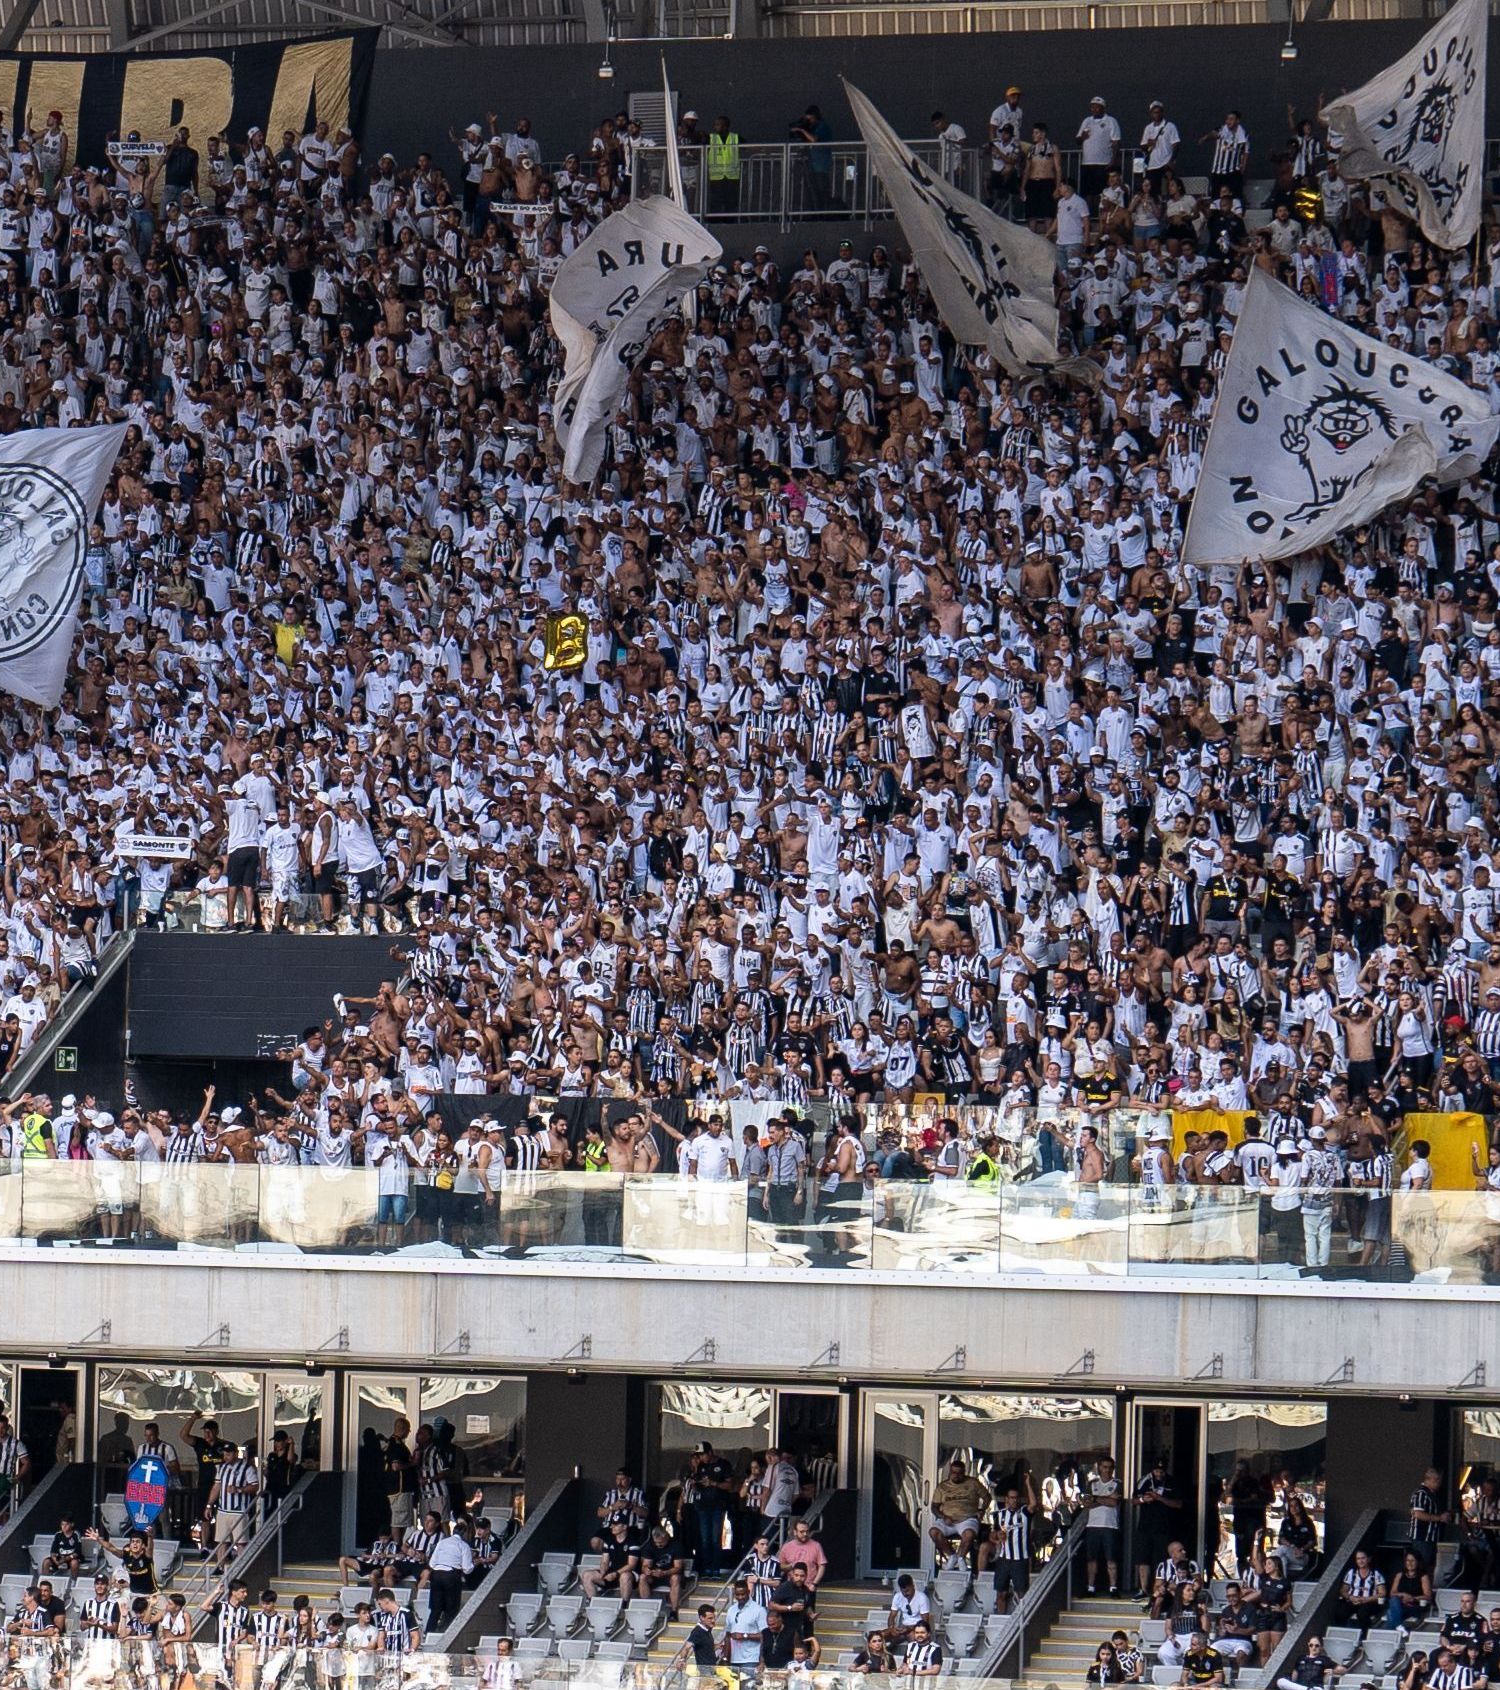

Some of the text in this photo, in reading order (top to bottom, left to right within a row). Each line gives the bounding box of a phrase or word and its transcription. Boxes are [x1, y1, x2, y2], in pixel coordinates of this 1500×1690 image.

[1238, 337, 1473, 454] GALOUCURA
[132, 840, 175, 850] SAMONTE
[593, 960, 612, 979] 92
